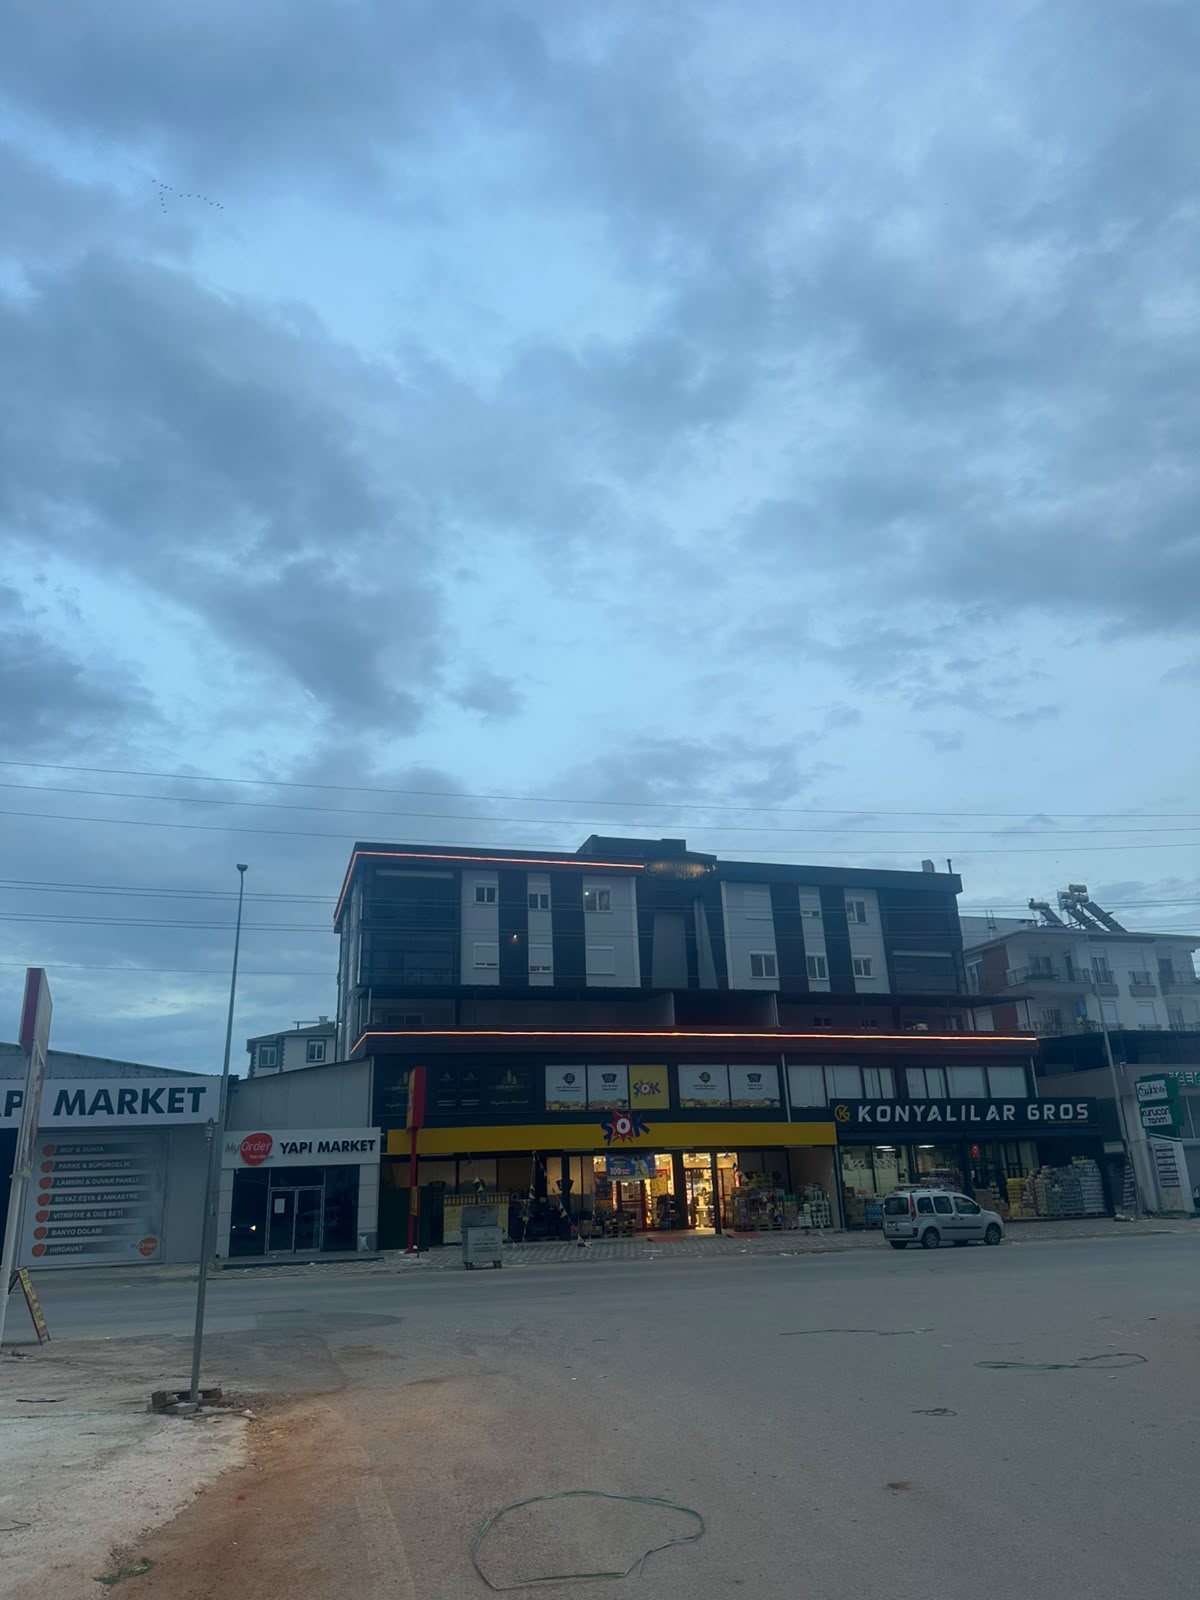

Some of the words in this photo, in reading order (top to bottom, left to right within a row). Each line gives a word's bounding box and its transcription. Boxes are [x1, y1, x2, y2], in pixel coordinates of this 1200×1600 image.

[53, 1087, 206, 1116] MARKET
[858, 1104, 1016, 1122] KONYALILAR
[1027, 1103, 1089, 1120] GROS
[601, 1111, 650, 1146] ŞOK
[241, 1140, 272, 1152] Order
[280, 1142, 313, 1154] YAPI
[317, 1139, 376, 1153] MARKET
